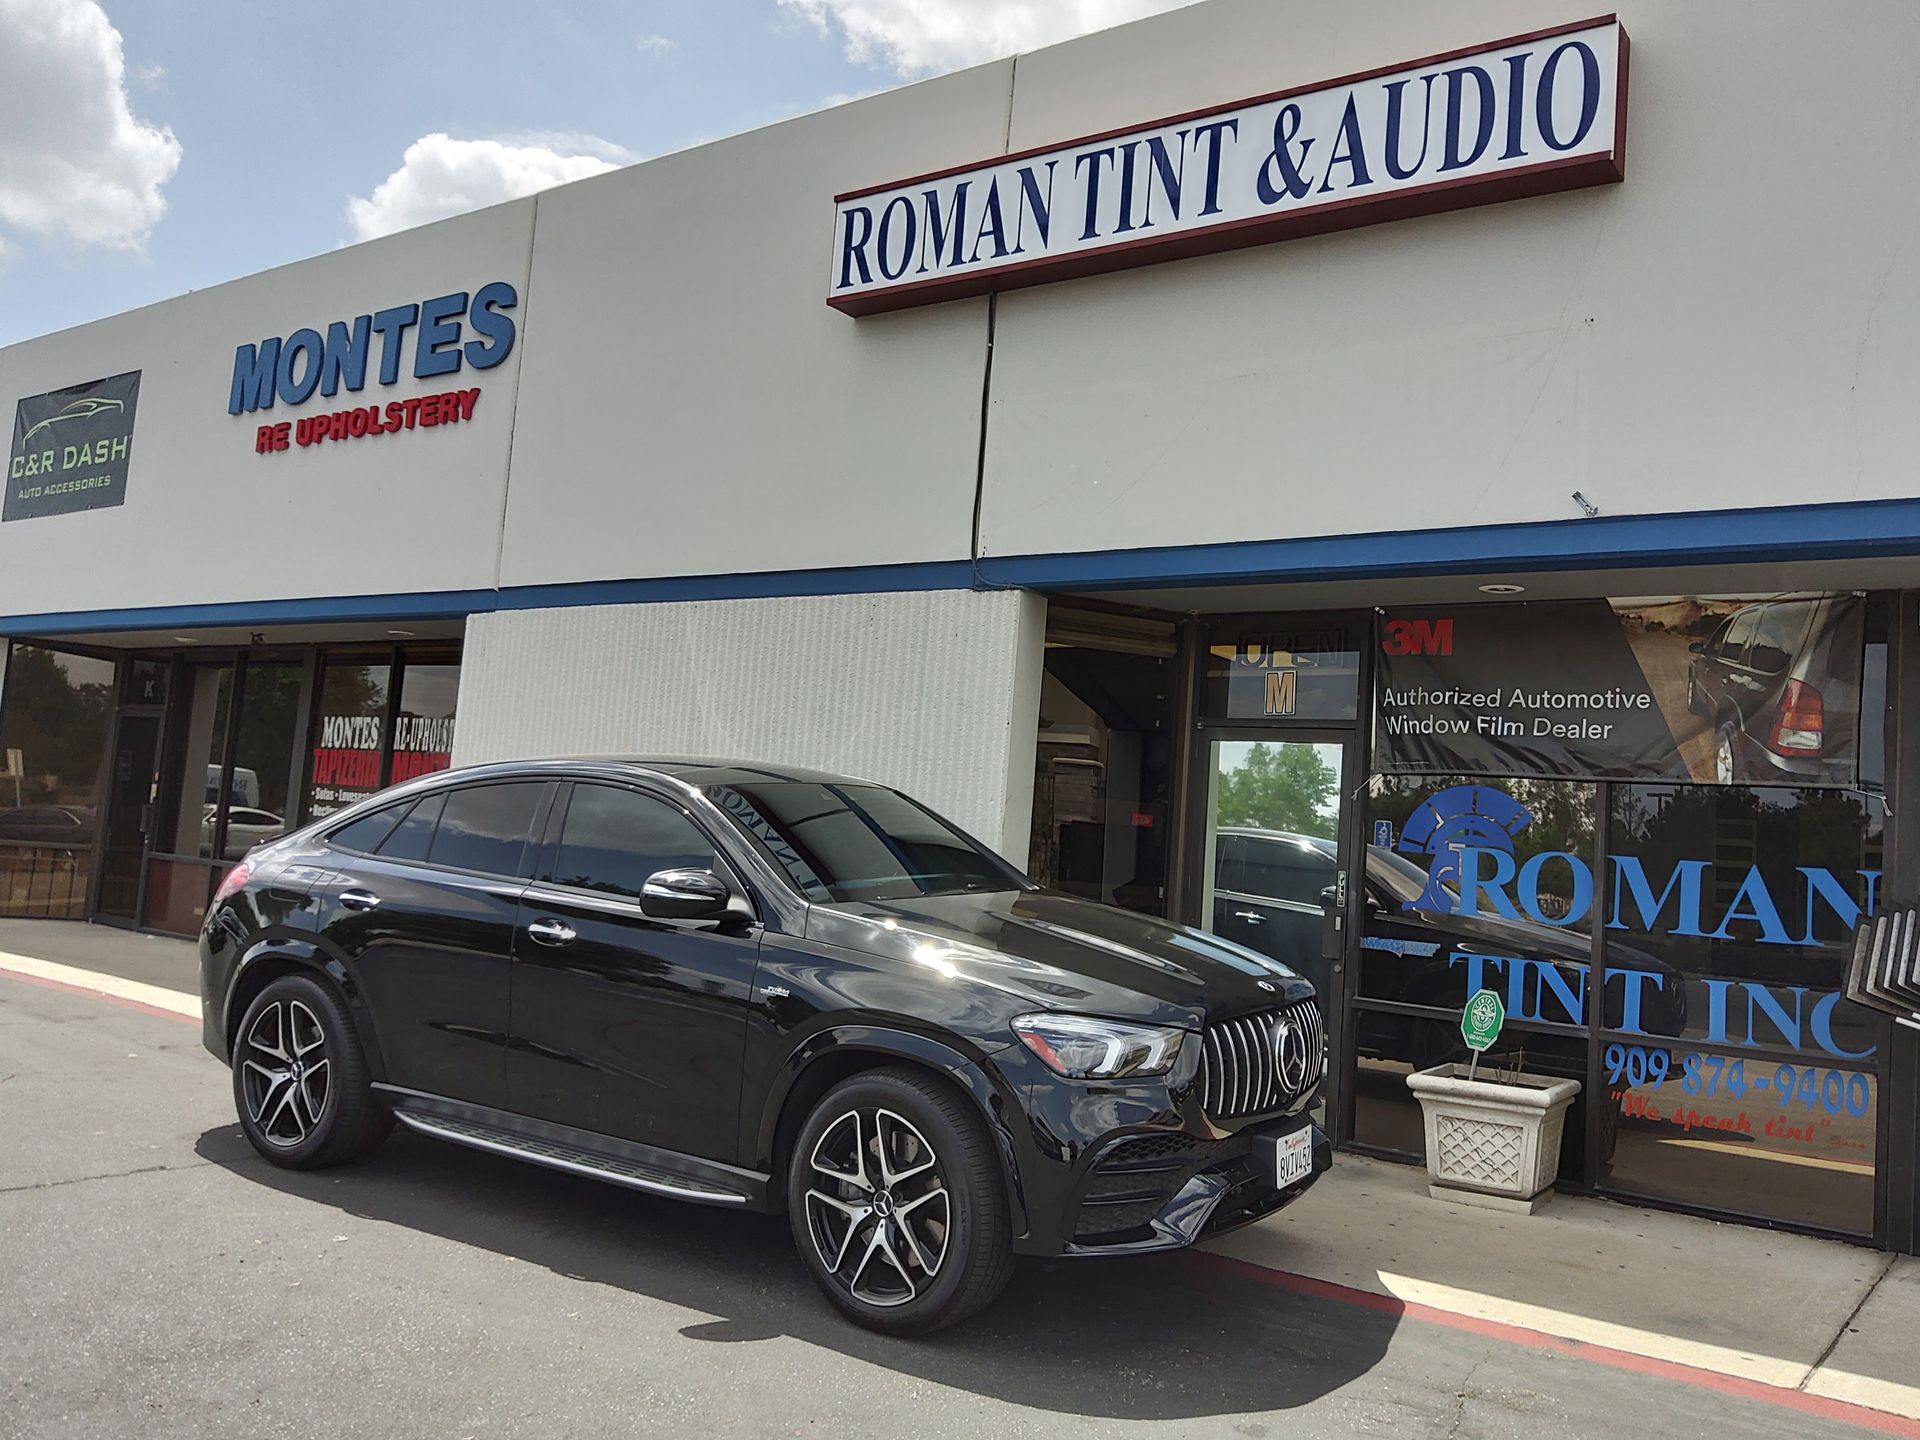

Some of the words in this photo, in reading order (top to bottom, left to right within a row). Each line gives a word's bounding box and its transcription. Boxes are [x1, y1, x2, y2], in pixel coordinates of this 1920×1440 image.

[836, 160, 1058, 289] ROMAN
[1074, 118, 1239, 241] TINT
[227, 281, 518, 416] MONTES
[255, 422, 291, 454] RE
[296, 387, 481, 447] UPHOLSTERY
[11, 450, 54, 479] C&R
[63, 436, 128, 470] DASH
[18, 486, 42, 500] AUTO
[44, 475, 111, 495] ACCESSORIES
[1382, 618, 1454, 656] 3M
[1264, 671, 1296, 715] M
[1383, 687, 1501, 710] Authorized
[1508, 687, 1651, 710] Automotive
[321, 716, 380, 750] MONTES
[1385, 714, 1470, 736] Window
[1477, 716, 1524, 737] Film
[1532, 717, 1612, 740] Dealer
[313, 748, 381, 787] TAPIZERIA
[391, 751, 452, 785] MONT
[1456, 846, 1882, 947] ROMAN
[1449, 952, 1664, 1035] TINT
[1701, 979, 1878, 1060] INC
[1604, 1042, 1669, 1091] 909
